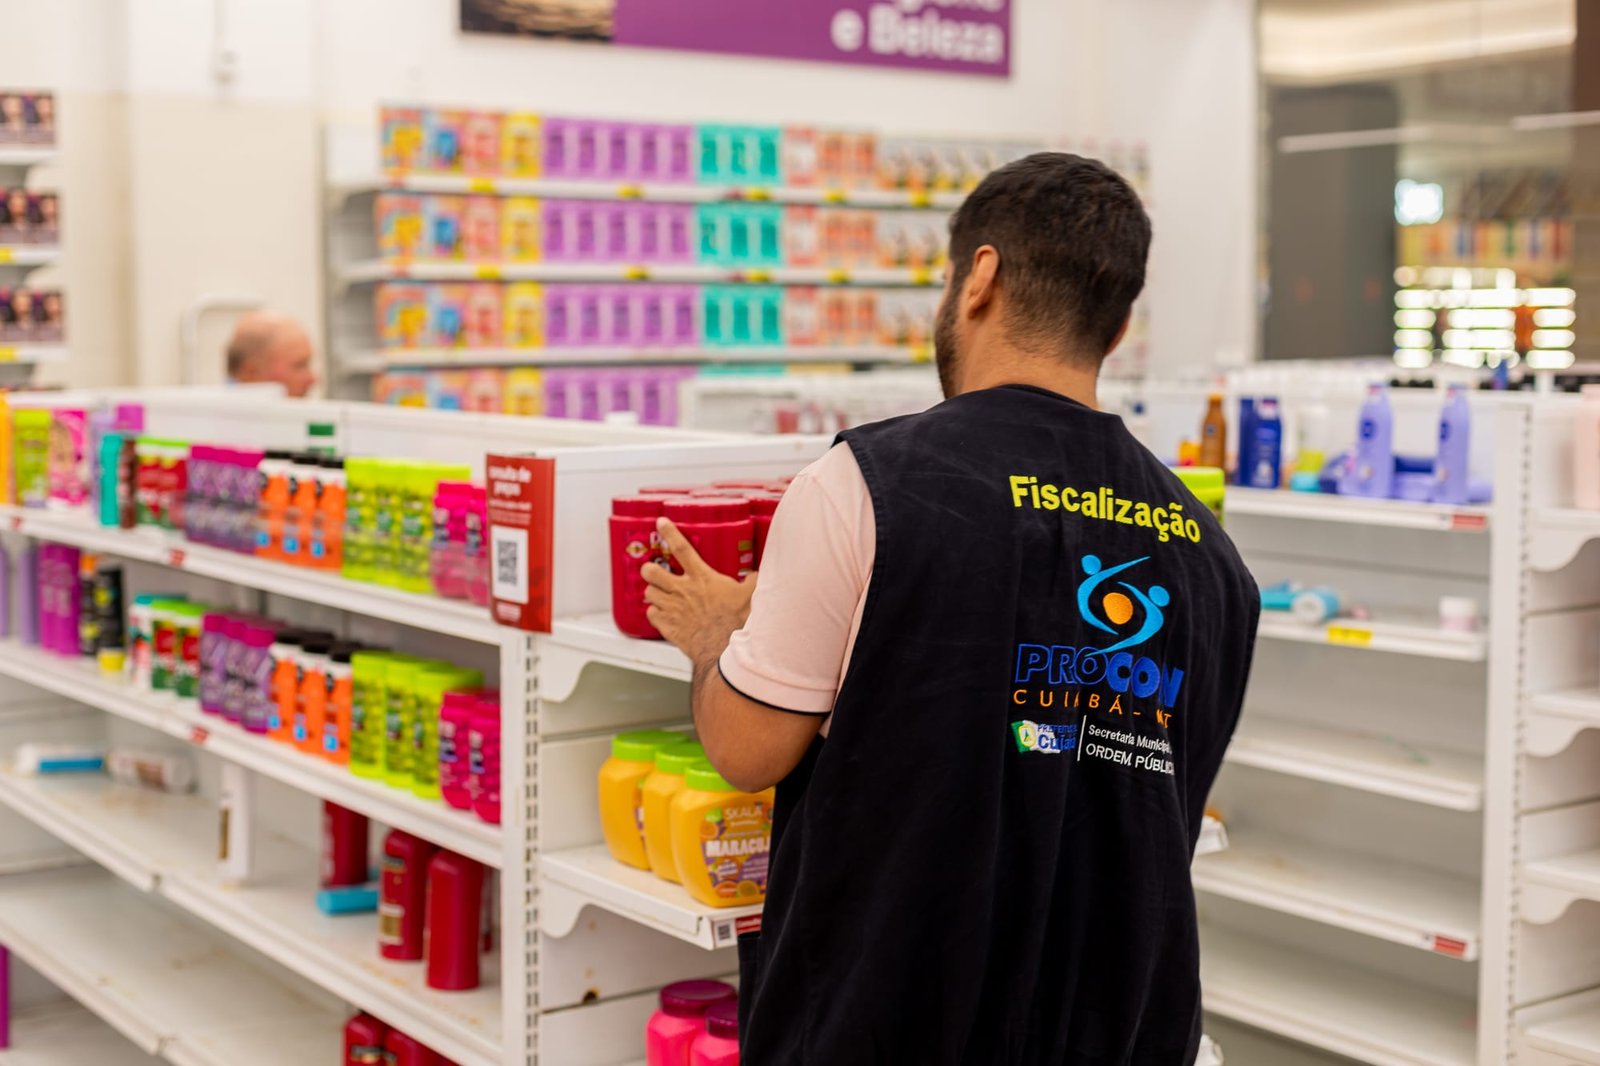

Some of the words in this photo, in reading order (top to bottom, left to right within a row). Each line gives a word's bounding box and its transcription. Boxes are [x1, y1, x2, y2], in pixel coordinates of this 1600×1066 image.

[830, 8, 864, 52] e
[868, 2, 1004, 64] Beleza
[1009, 475, 1201, 543] Fiscalização
[1015, 643, 1184, 708] PROCON
[1086, 743, 1133, 766] ORDEM
[1088, 724, 1135, 745] Secretaria
